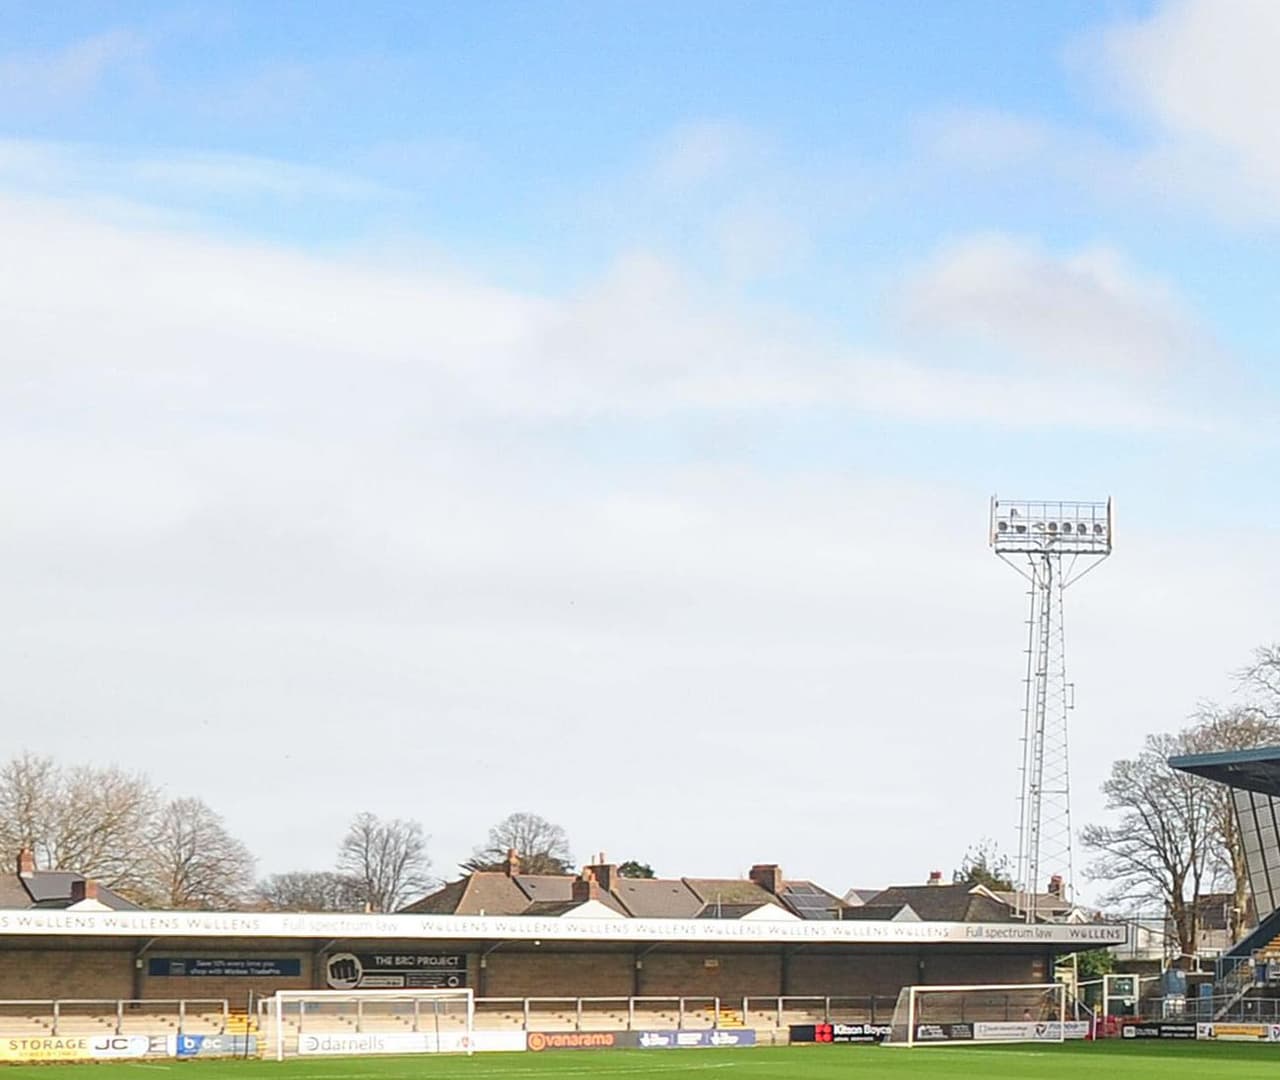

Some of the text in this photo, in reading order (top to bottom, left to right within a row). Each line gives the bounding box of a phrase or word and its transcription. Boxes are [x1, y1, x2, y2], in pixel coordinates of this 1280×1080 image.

[966, 925, 984, 937] Full
[985, 927, 1034, 940] spectrum
[417, 956, 459, 966] PROJECT
[9, 1039, 87, 1051] STORAGE
[322, 1035, 384, 1051] darnells
[547, 1033, 614, 1046] vanarama
